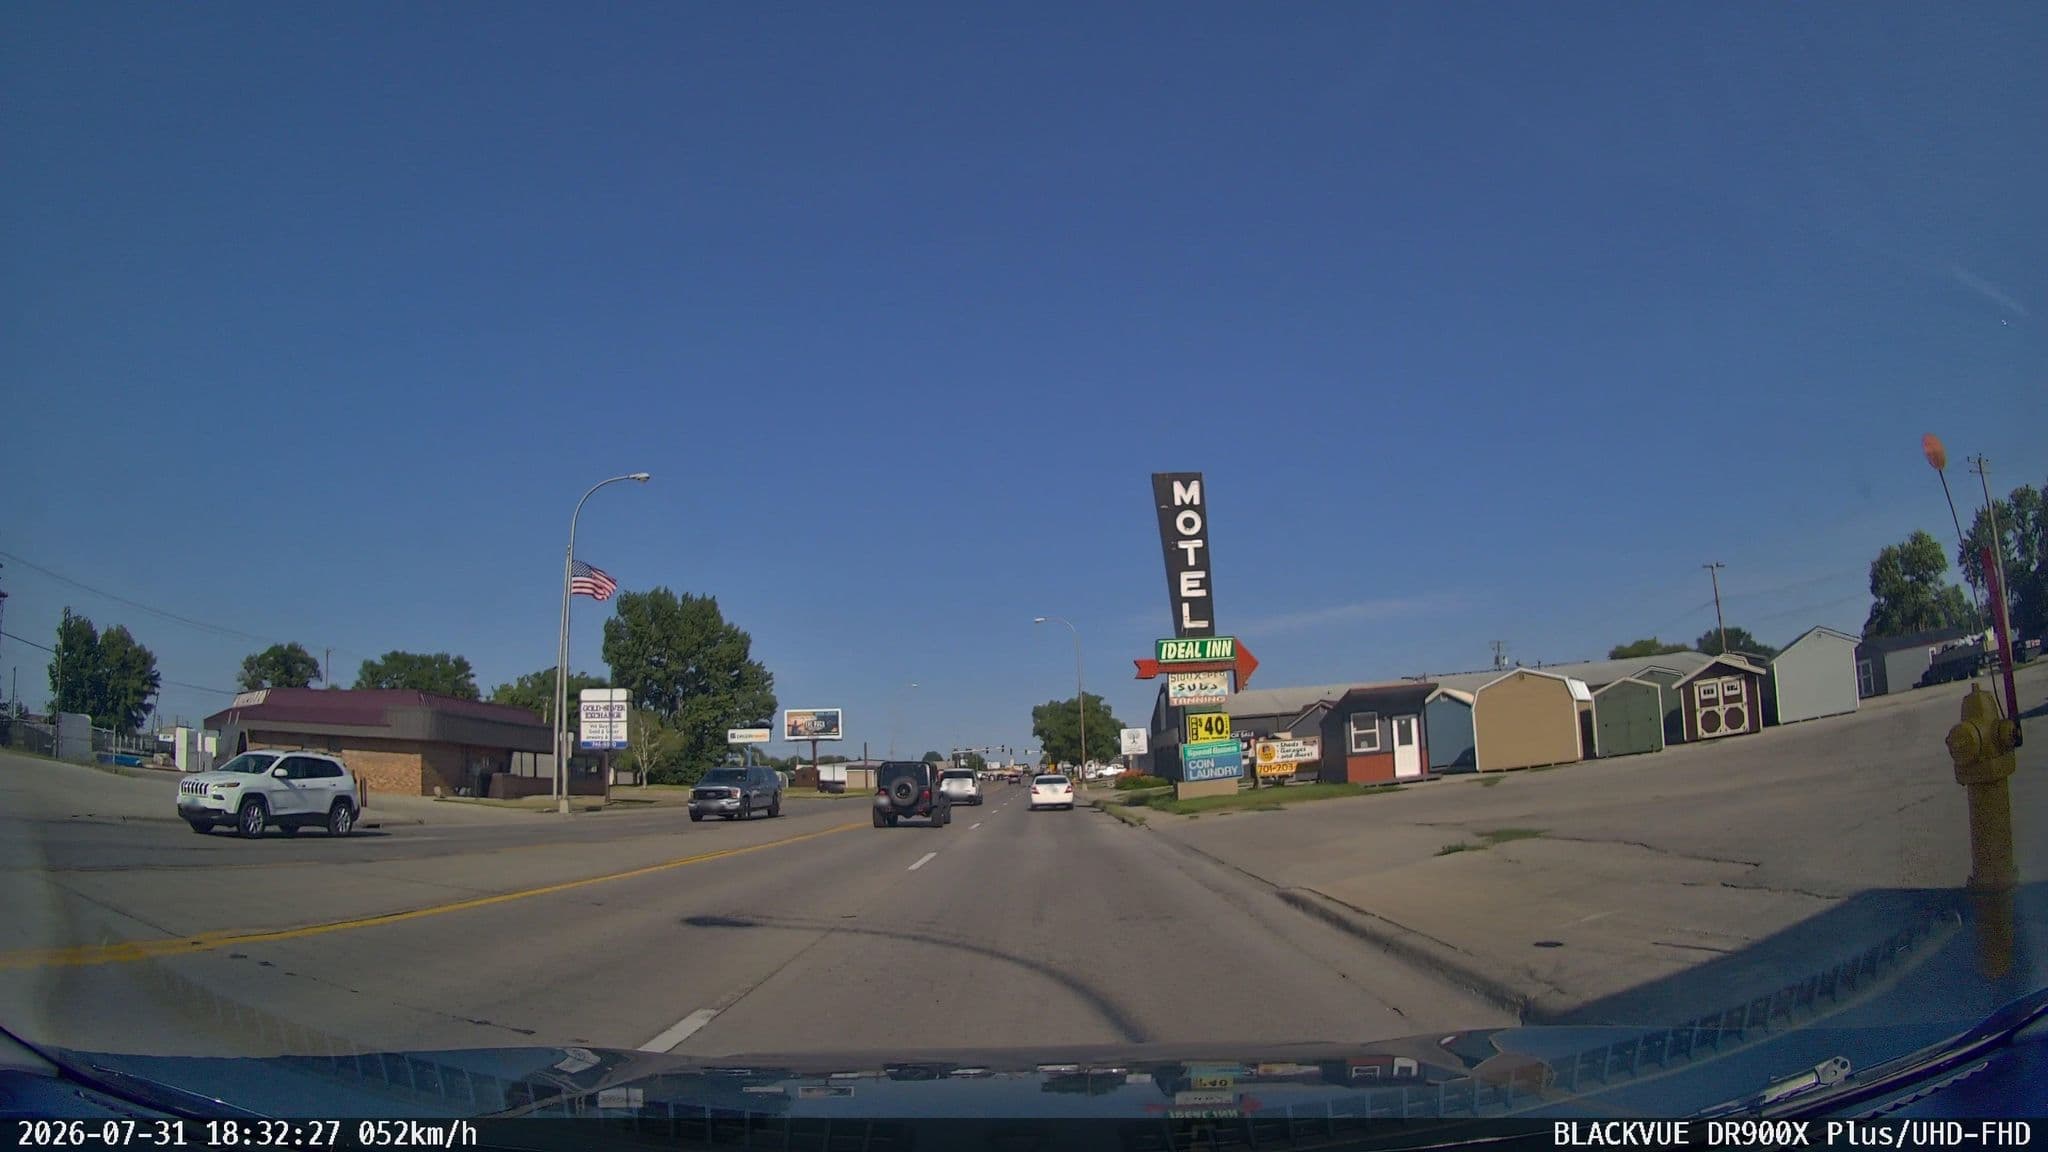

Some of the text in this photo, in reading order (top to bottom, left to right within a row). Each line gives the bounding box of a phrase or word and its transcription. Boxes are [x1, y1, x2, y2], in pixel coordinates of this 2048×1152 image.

[1173, 480, 1208, 628] MOTEL
[1161, 640, 1232, 659] IDEAL INN
[1189, 758, 1215, 769] COIN
[1190, 765, 1238, 779] LAUNDRY
